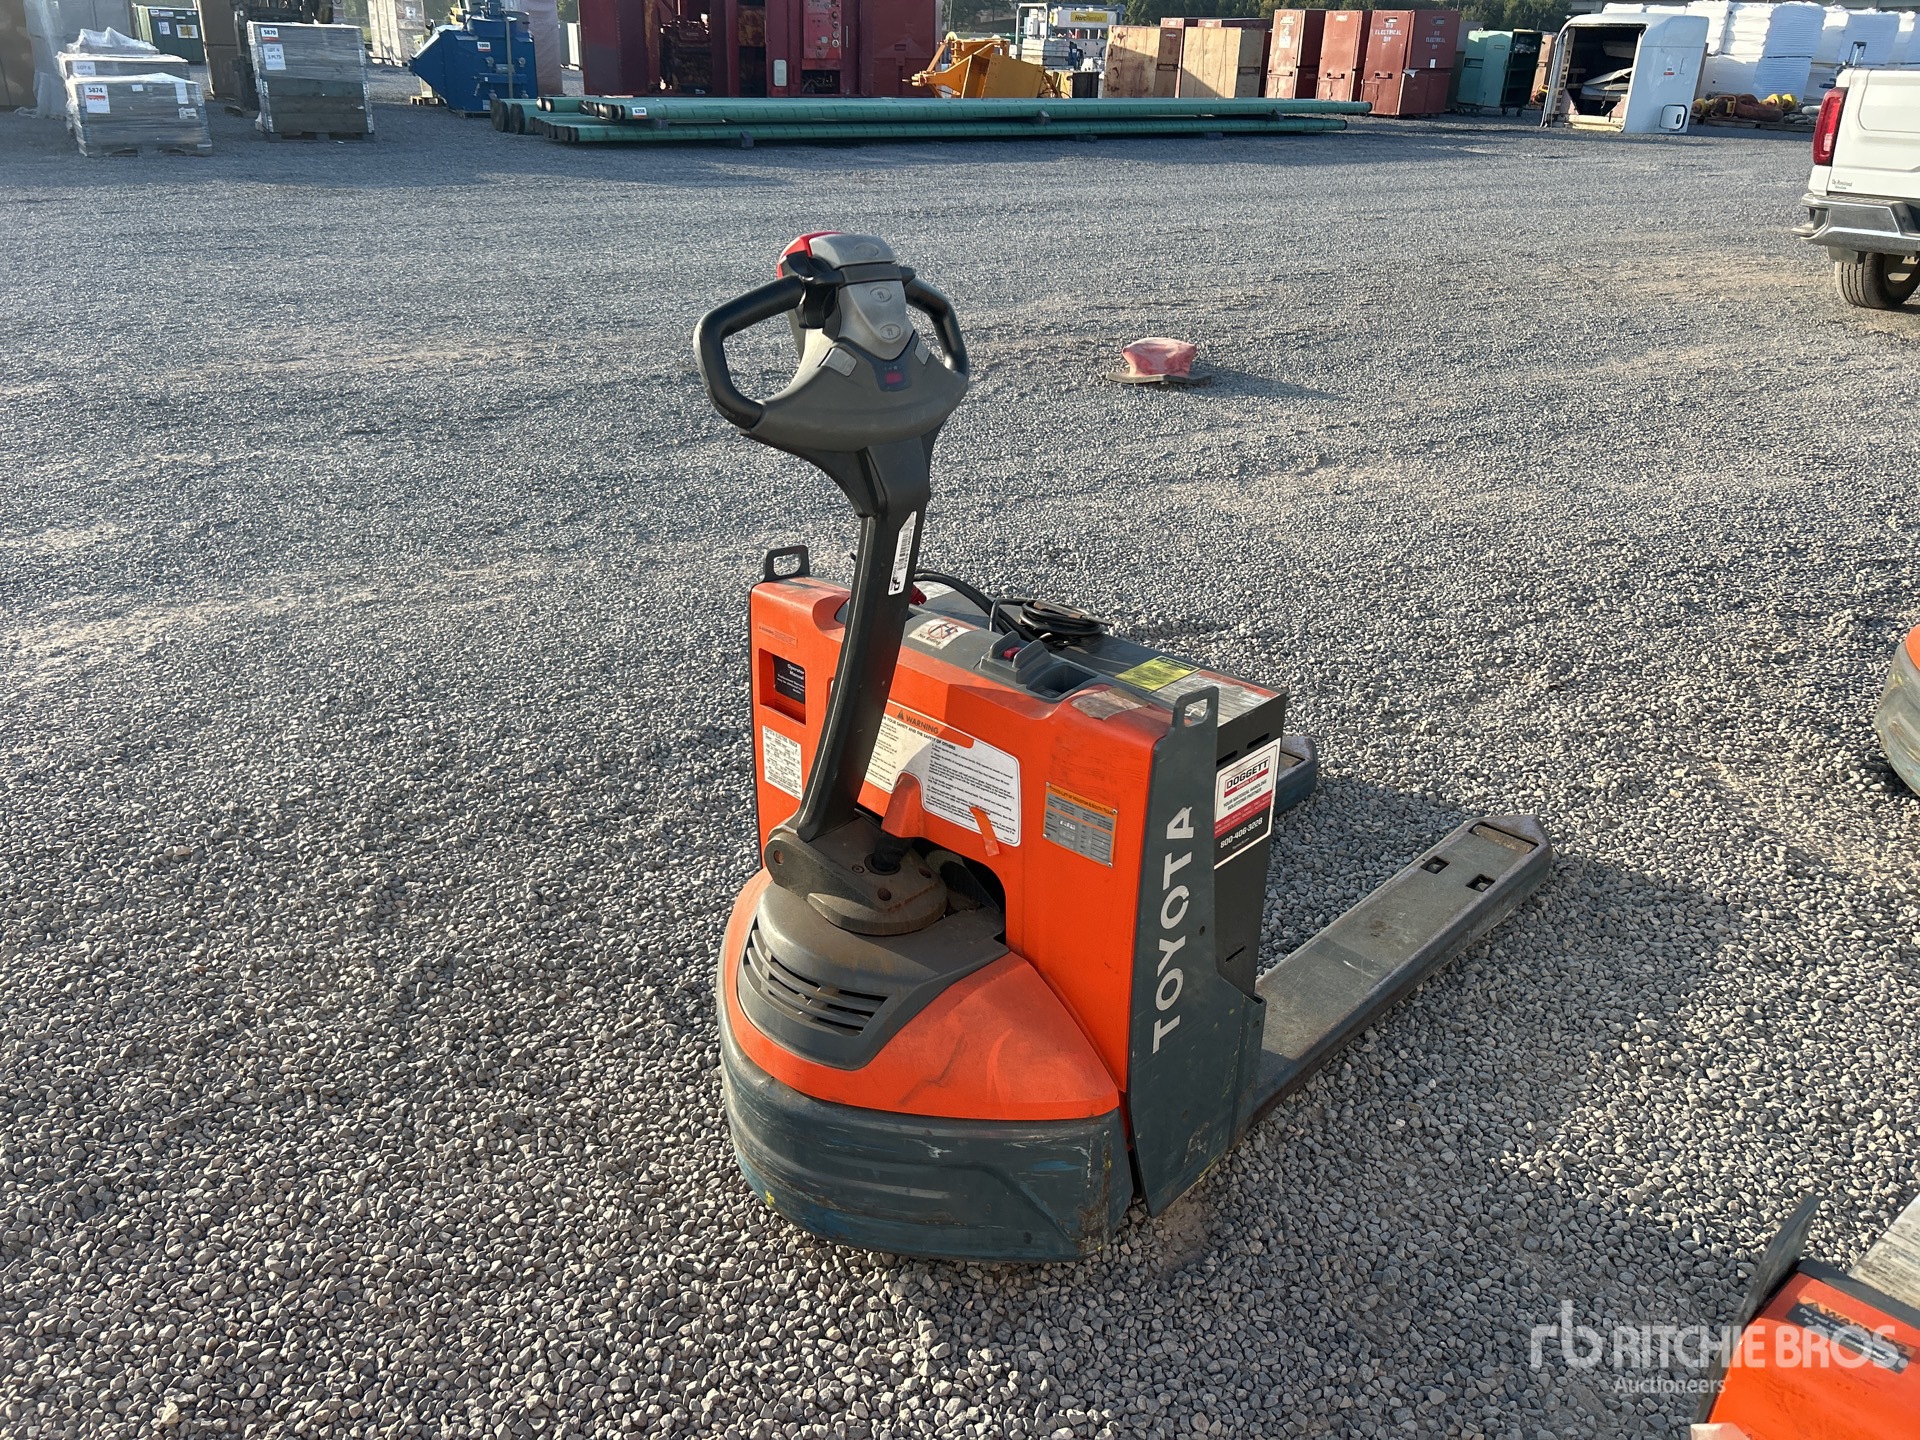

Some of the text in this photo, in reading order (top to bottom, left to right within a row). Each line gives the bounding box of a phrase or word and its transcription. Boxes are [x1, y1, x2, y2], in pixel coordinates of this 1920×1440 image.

[906, 714, 939, 735] WARNING
[1227, 759, 1268, 789] DOGGETT
[1152, 806, 1195, 1055] TOYOTA
